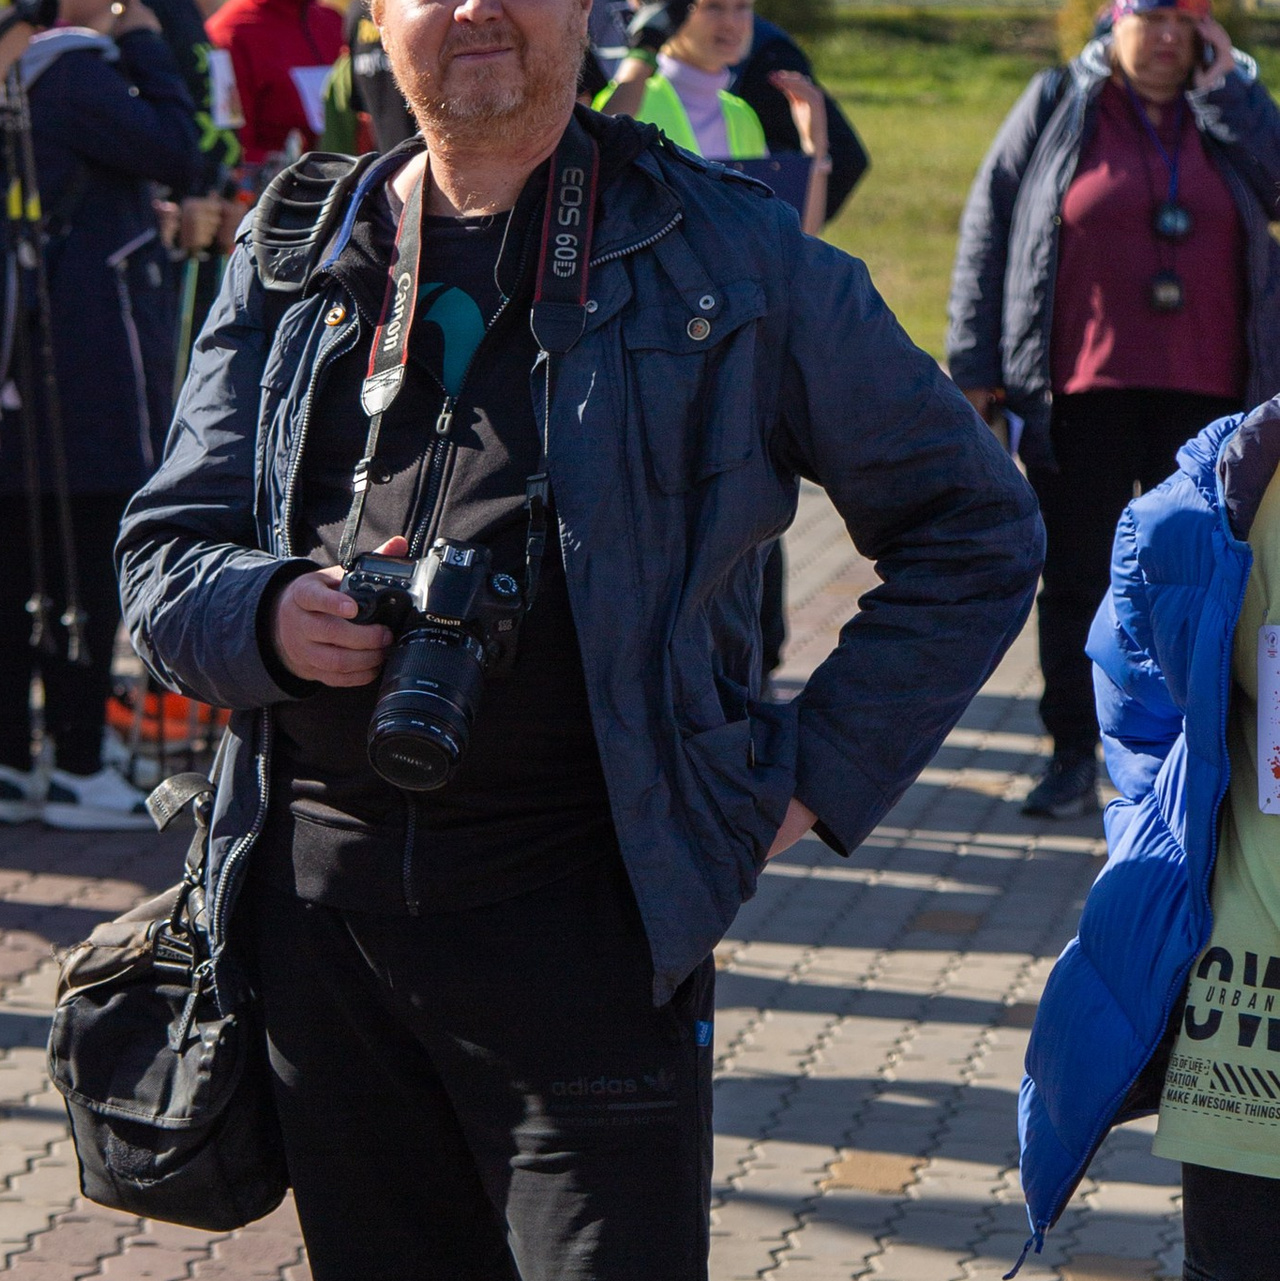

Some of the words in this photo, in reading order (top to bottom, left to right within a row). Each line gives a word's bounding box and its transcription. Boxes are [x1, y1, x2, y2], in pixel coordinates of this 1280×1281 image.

[558, 167, 584, 226] EOS
[553, 233, 578, 278] 60D
[383, 272, 411, 352] Canon
[425, 613, 461, 626] Canon
[1205, 985, 1275, 1012] URBAN
[1179, 1058, 1188, 1069] OF
[1189, 1060, 1204, 1073] LIFE
[1166, 1088, 1191, 1105] MAKE
[1191, 1093, 1242, 1114] AWESOME
[1244, 1103, 1280, 1120] THINGS
